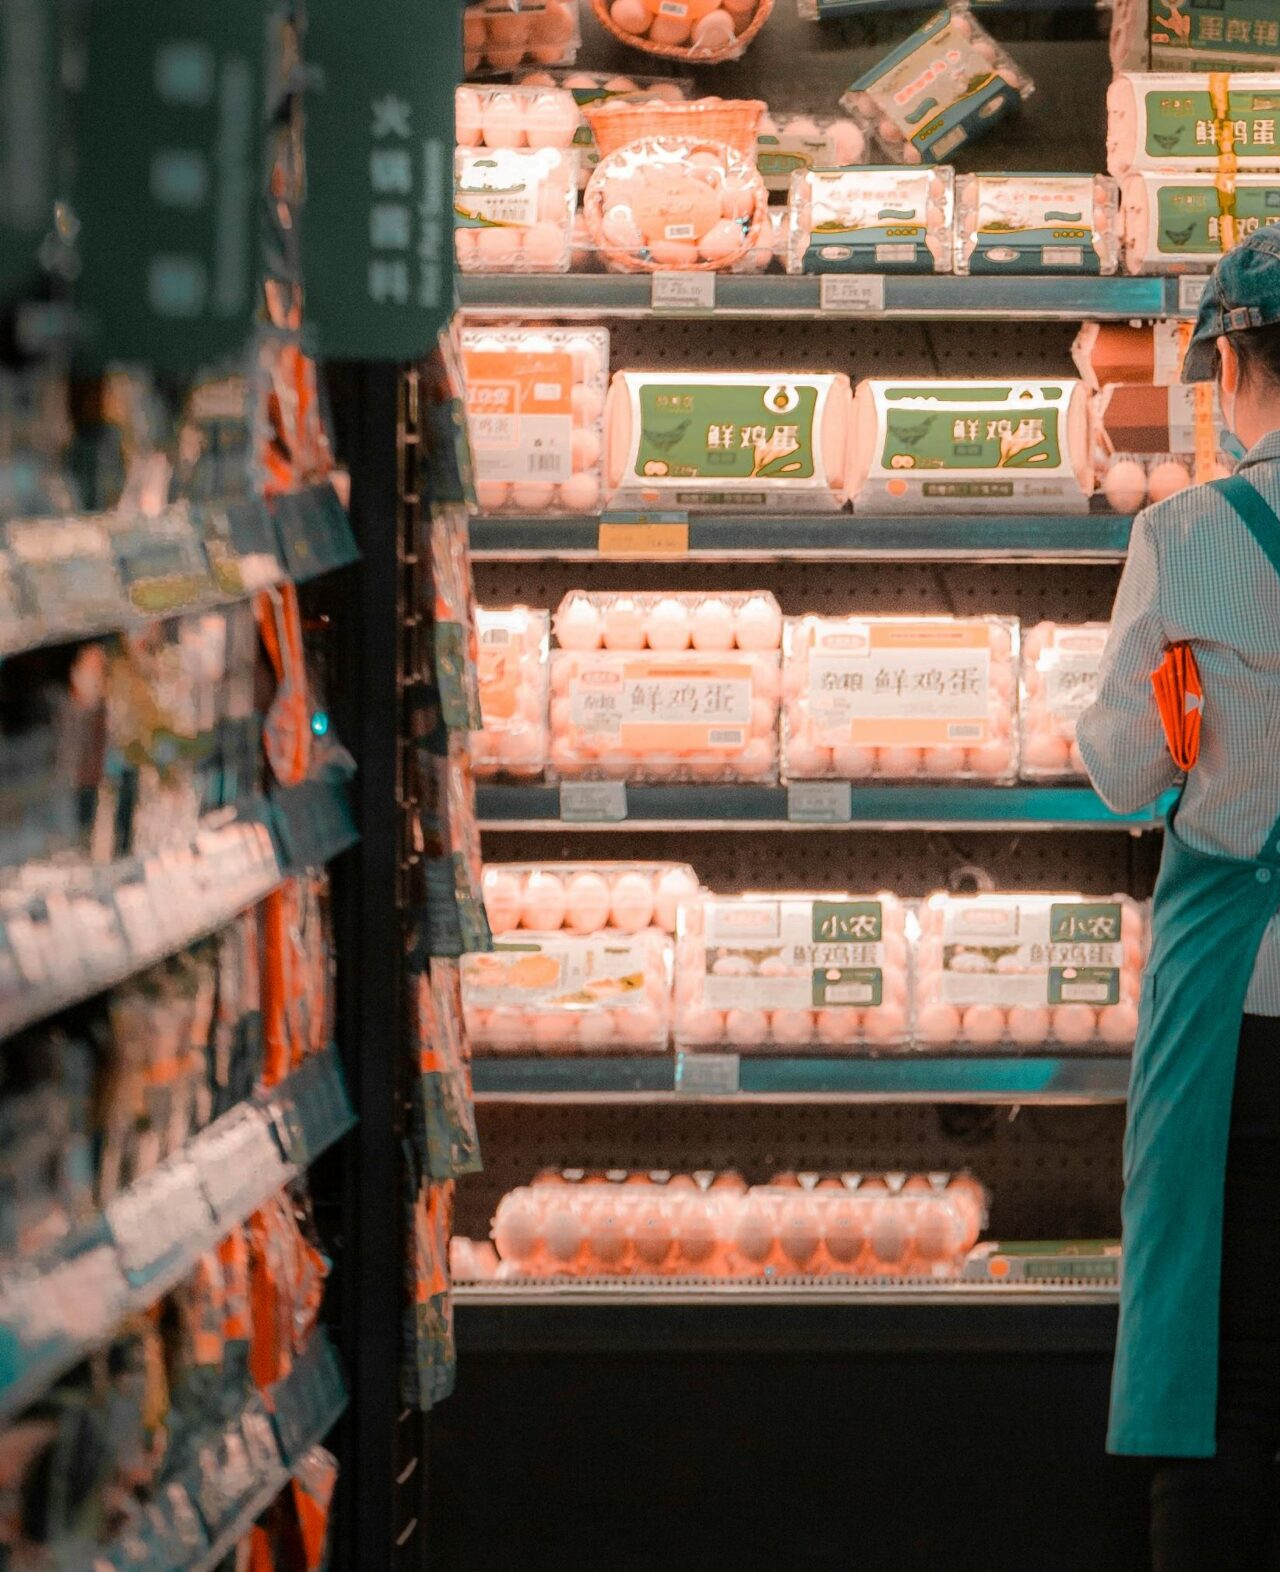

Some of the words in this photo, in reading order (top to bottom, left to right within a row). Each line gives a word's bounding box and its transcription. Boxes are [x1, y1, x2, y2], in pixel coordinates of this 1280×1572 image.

[707, 424, 800, 449] 鲜鸡蛋
[953, 418, 1044, 441] 鲜鸡蛋
[874, 665, 981, 696] 鲜鸡蛋
[630, 682, 735, 713] 鲜鸡蛋
[821, 914, 877, 938] 小农
[1059, 916, 1116, 938] 小农
